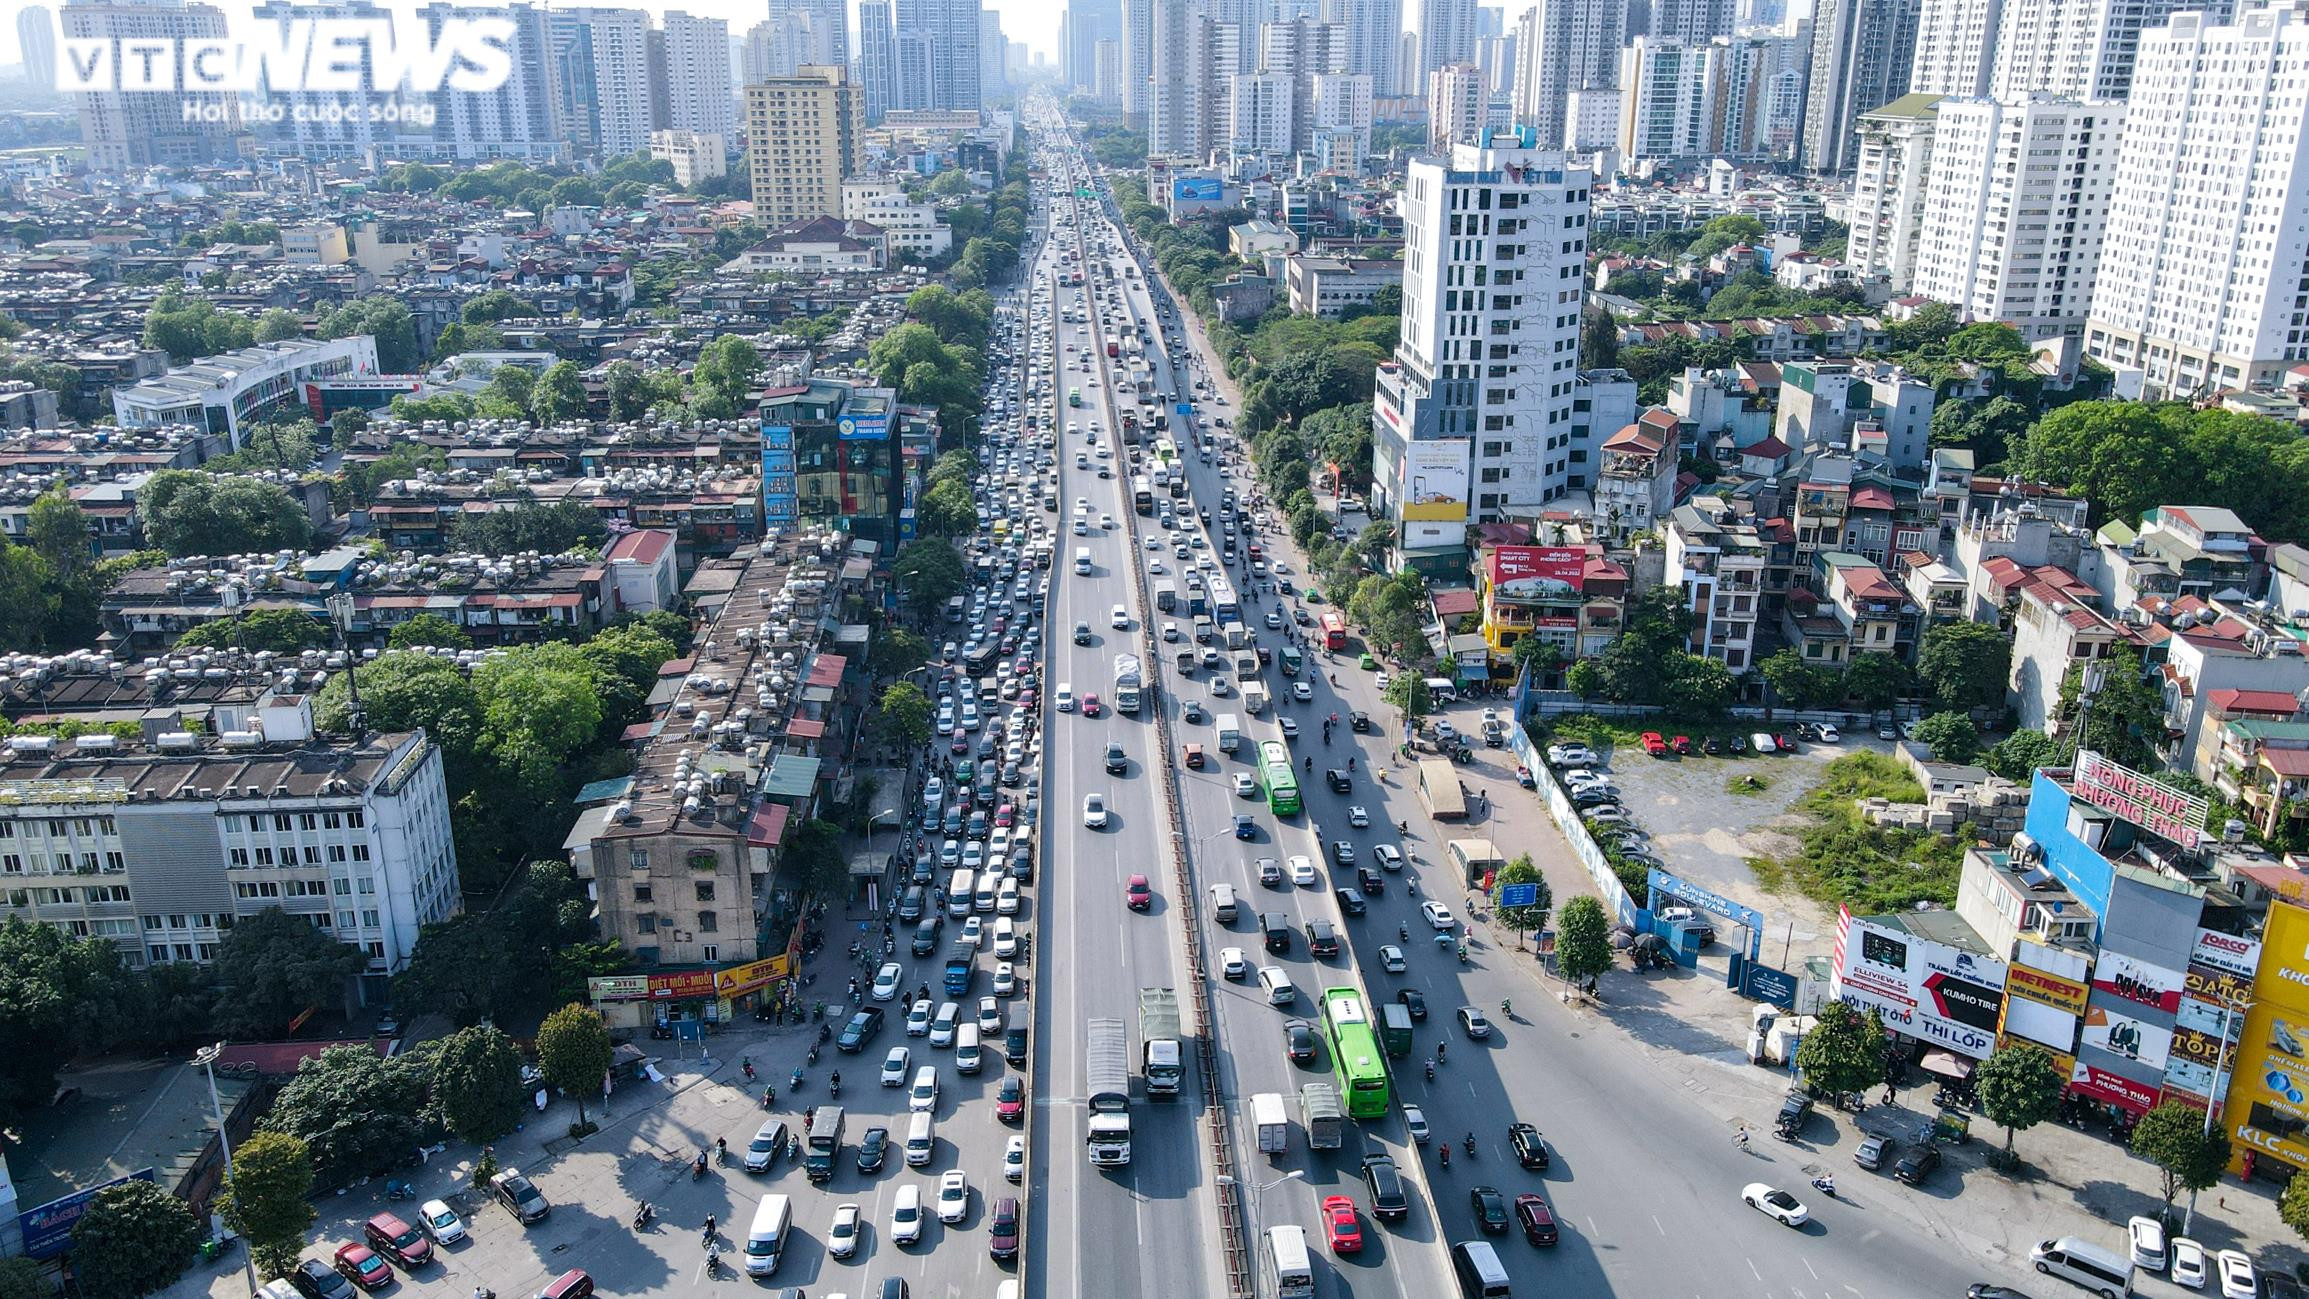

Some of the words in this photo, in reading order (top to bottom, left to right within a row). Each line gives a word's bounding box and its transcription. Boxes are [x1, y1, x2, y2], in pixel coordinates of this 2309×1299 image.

[1943, 988, 1976, 1006] KUMHO
[1978, 998, 1998, 1012] TIRE
[1922, 1020, 1948, 1039] THI
[1952, 1030, 1986, 1050] LỐP
[2236, 1125, 2281, 1152] KLC
